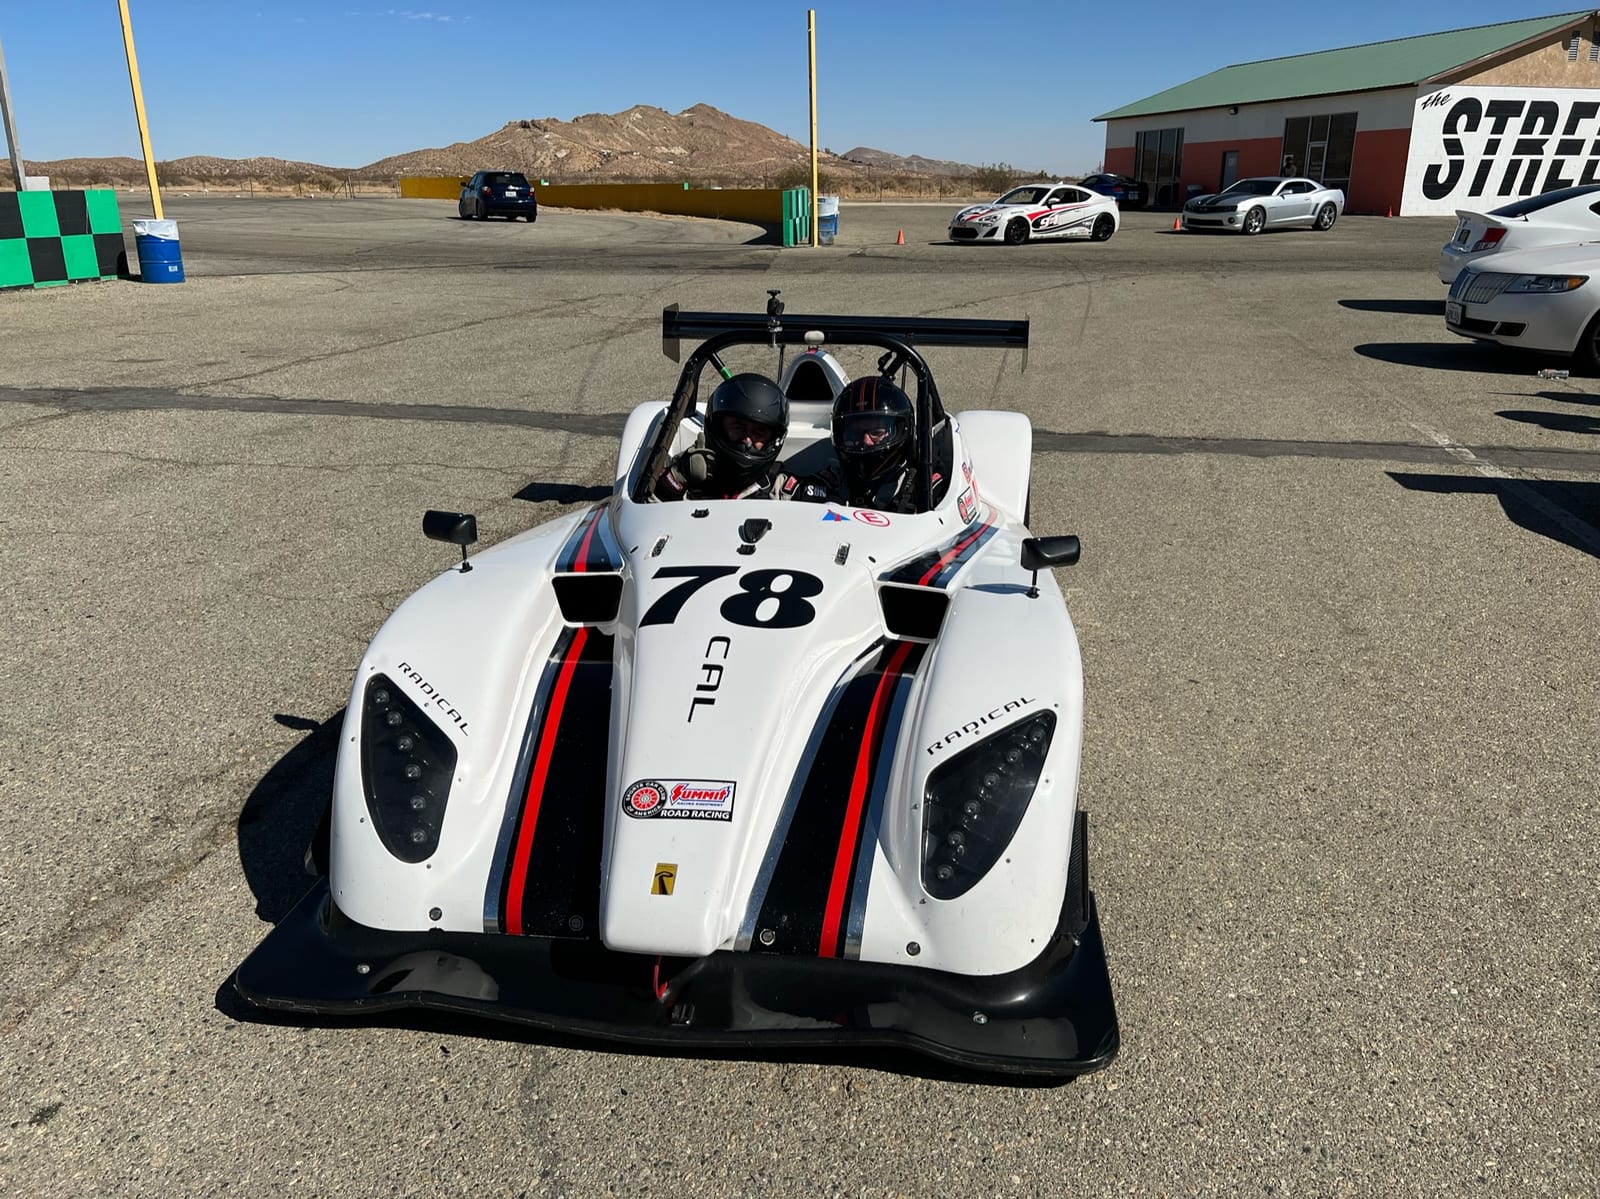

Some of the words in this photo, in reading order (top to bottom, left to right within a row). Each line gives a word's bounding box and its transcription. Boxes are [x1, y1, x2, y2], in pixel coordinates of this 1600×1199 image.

[1421, 91, 1451, 111] the
[860, 512, 883, 524] E
[638, 565, 824, 629] 78
[687, 635, 731, 723] CAL
[398, 662, 469, 737] RADICAL
[927, 696, 1036, 755] RADICAL
[634, 805, 661, 816] AMERICA
[660, 809, 689, 818] ROAD
[691, 810, 730, 819] RACING
